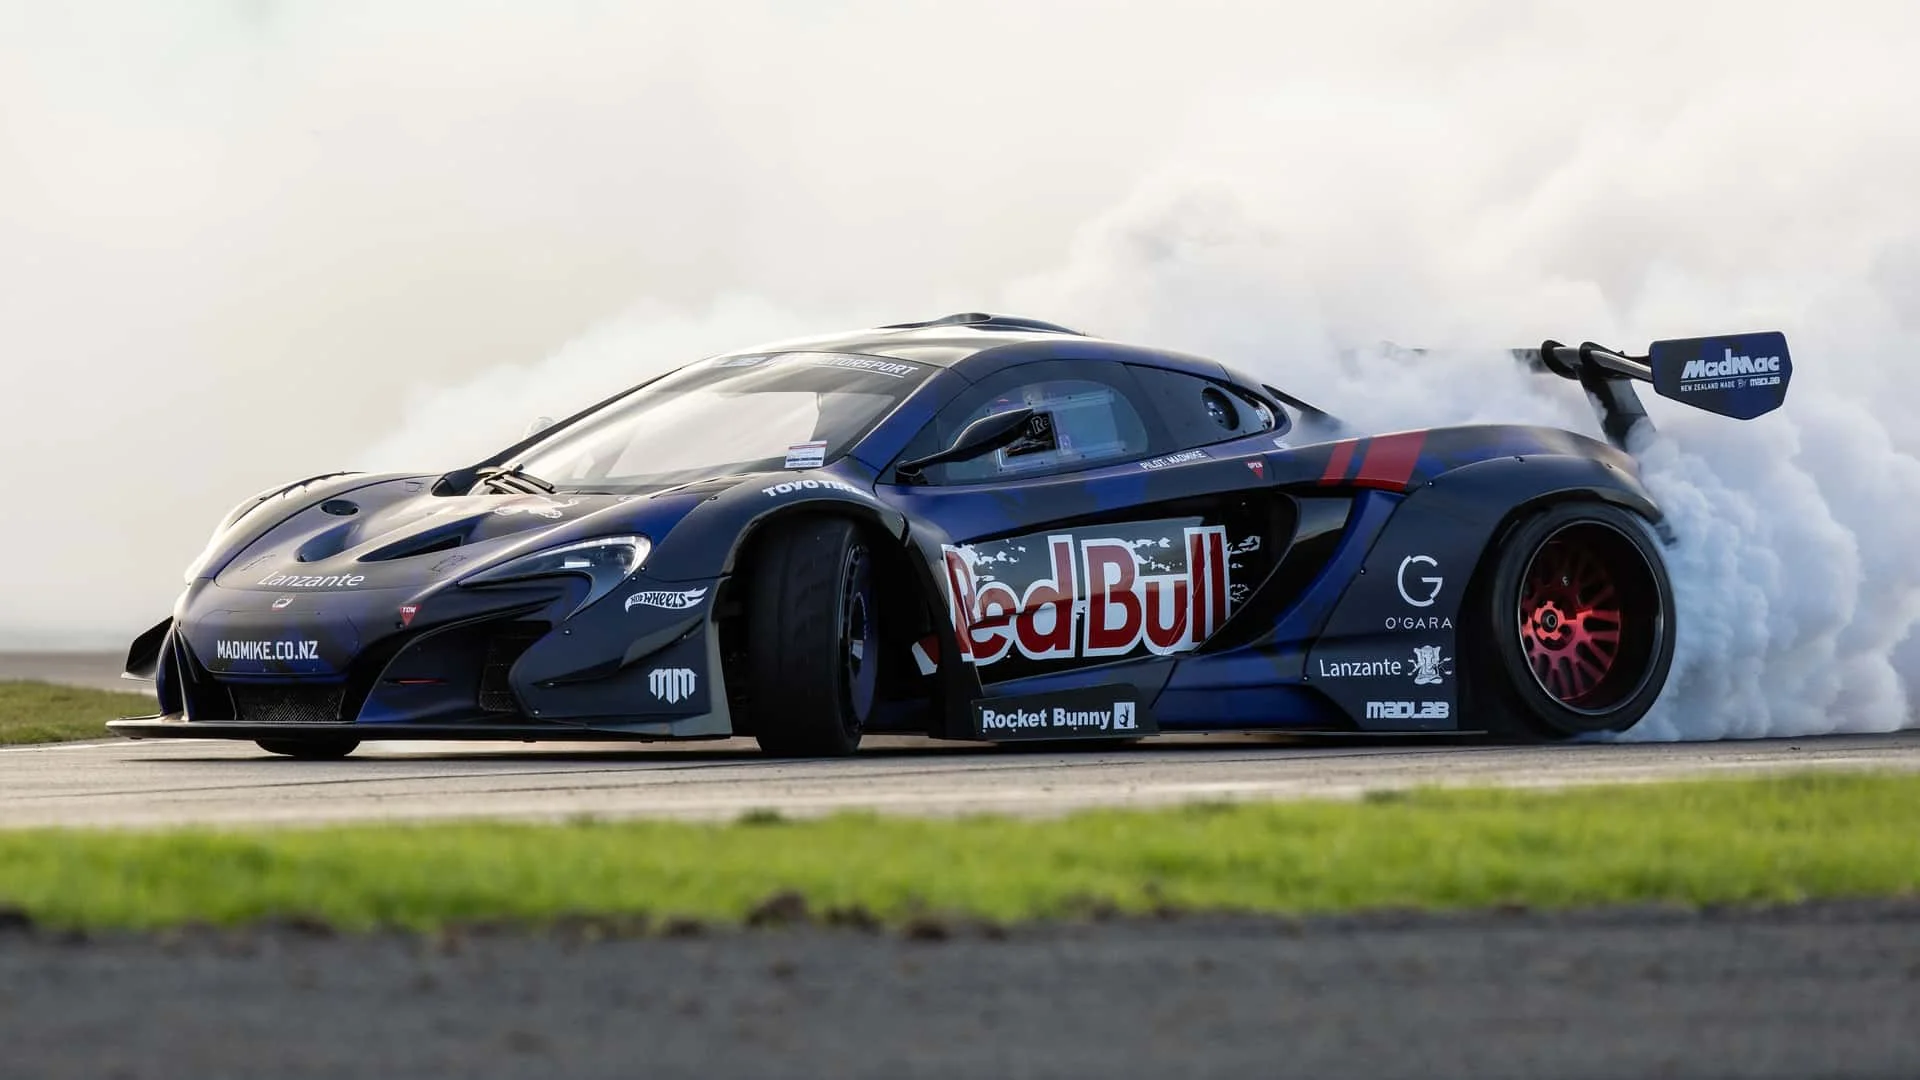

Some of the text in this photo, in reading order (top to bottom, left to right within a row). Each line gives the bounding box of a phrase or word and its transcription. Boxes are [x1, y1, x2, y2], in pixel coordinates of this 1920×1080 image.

[1681, 348, 1780, 379] MadMac
[1694, 382, 1719, 391] ZEALAND
[1720, 380, 1736, 389] MADE
[762, 479, 820, 497] TOYO
[257, 571, 365, 587] Lanzante
[941, 525, 1231, 666] Red Bull
[1385, 617, 1452, 629] O'GARA
[217, 640, 319, 660] MADMIKE.CO.NZ
[1319, 659, 1401, 677] Lanzante
[982, 707, 1111, 729] Rocket Bunny
